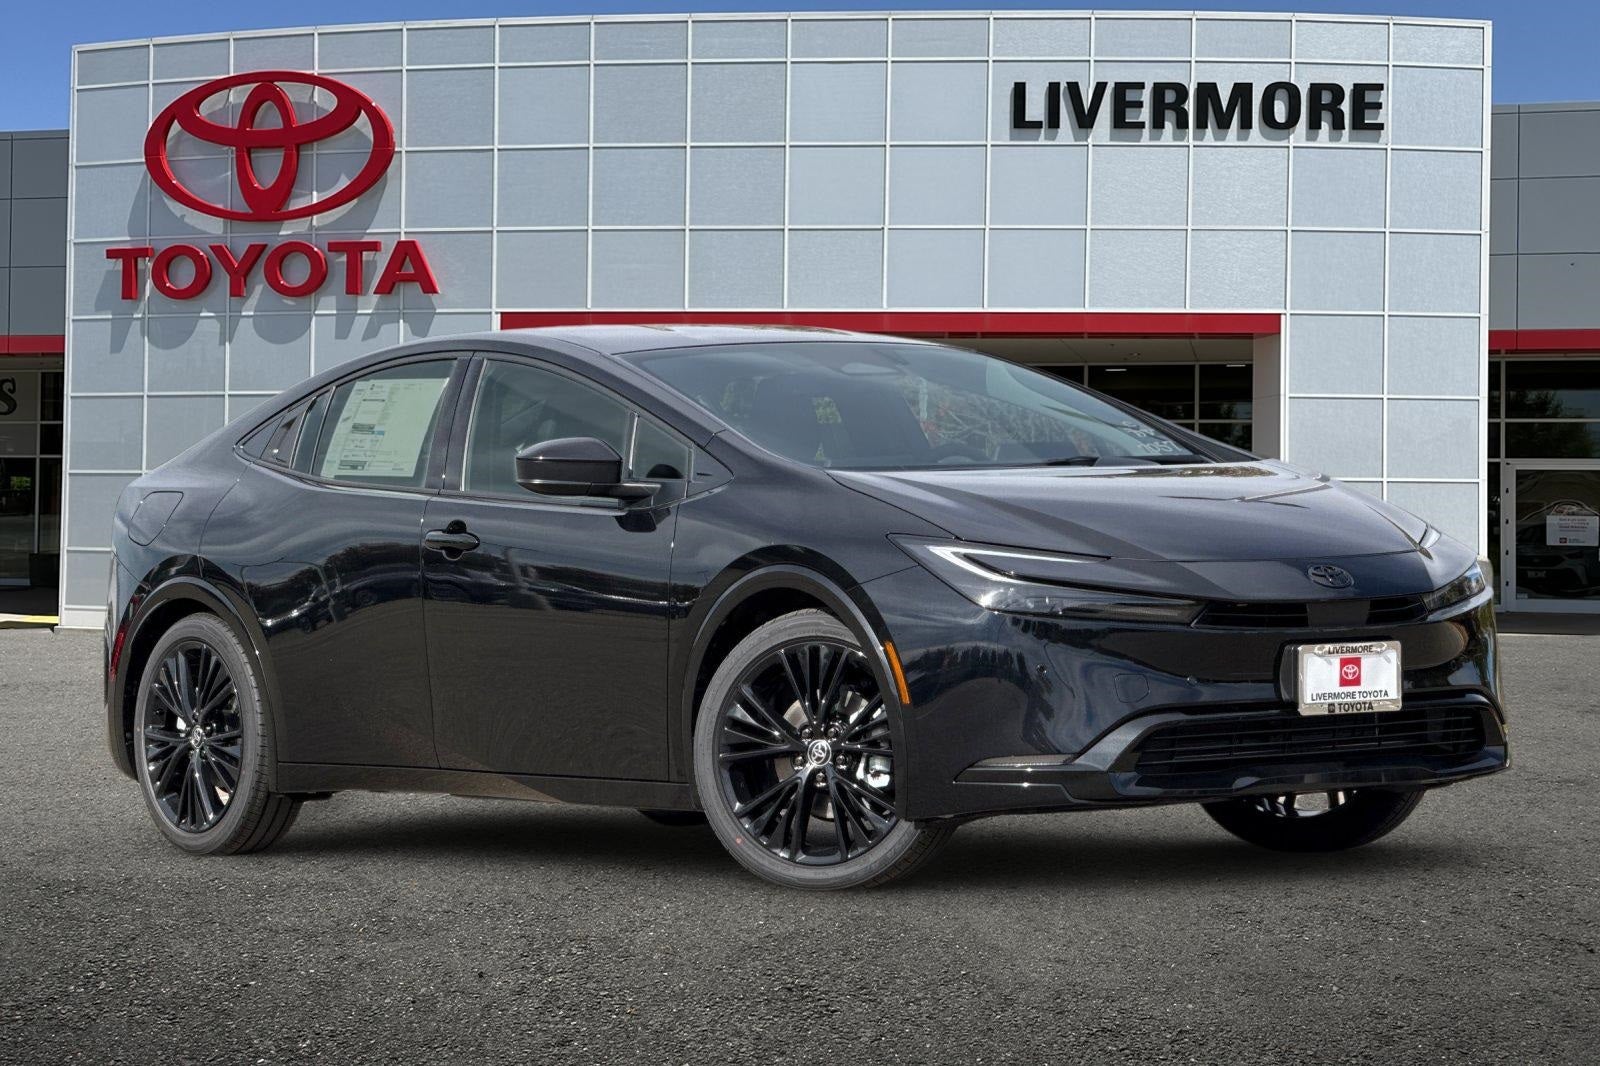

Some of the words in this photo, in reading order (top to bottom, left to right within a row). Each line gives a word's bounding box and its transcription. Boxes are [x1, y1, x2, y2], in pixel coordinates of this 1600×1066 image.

[1013, 81, 1385, 131] LIVERMORE
[106, 240, 440, 300] TOYOTA
[1328, 645, 1374, 655] LIVERMORE
[1311, 692, 1356, 701] LIVERMORE
[1358, 690, 1389, 699] TOYOTA
[1338, 702, 1374, 712] TOYOTA
